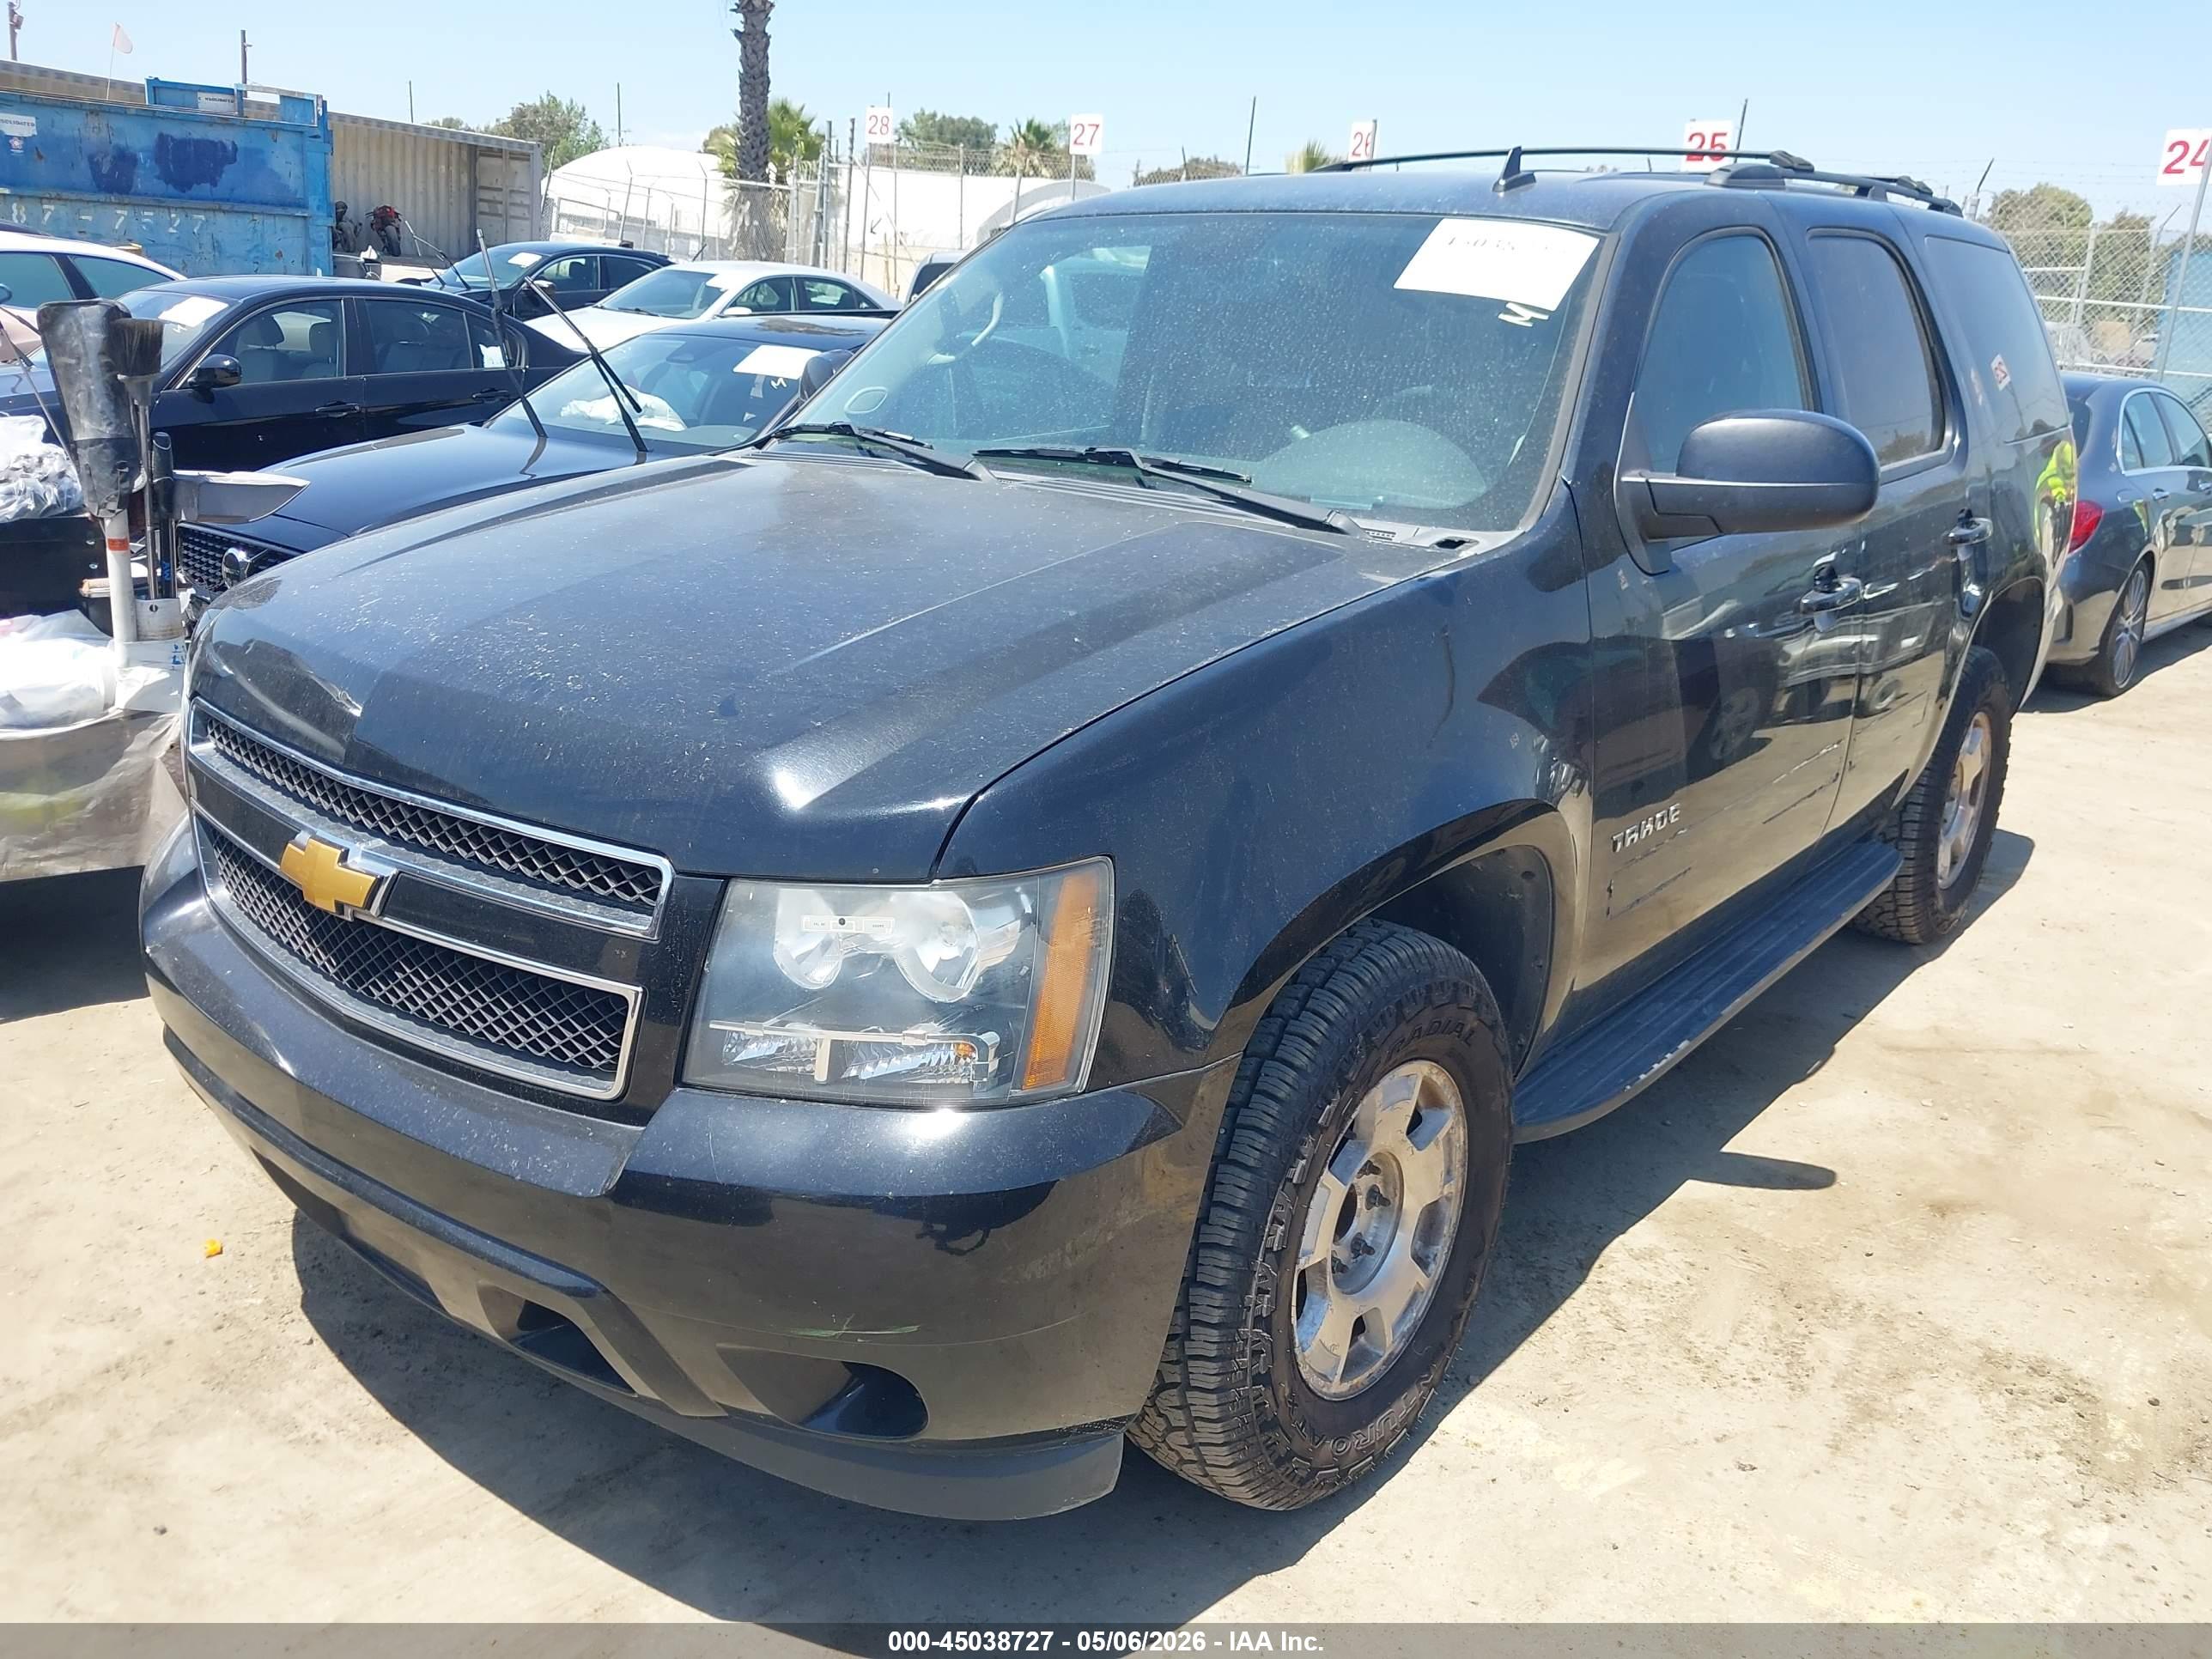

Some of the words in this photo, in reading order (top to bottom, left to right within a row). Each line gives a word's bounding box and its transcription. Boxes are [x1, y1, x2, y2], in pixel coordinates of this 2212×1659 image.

[868, 114, 890, 136] 28
[1073, 123, 1100, 146] 27
[1686, 131, 1727, 161] 25
[1611, 802, 1681, 853] TAHOE
